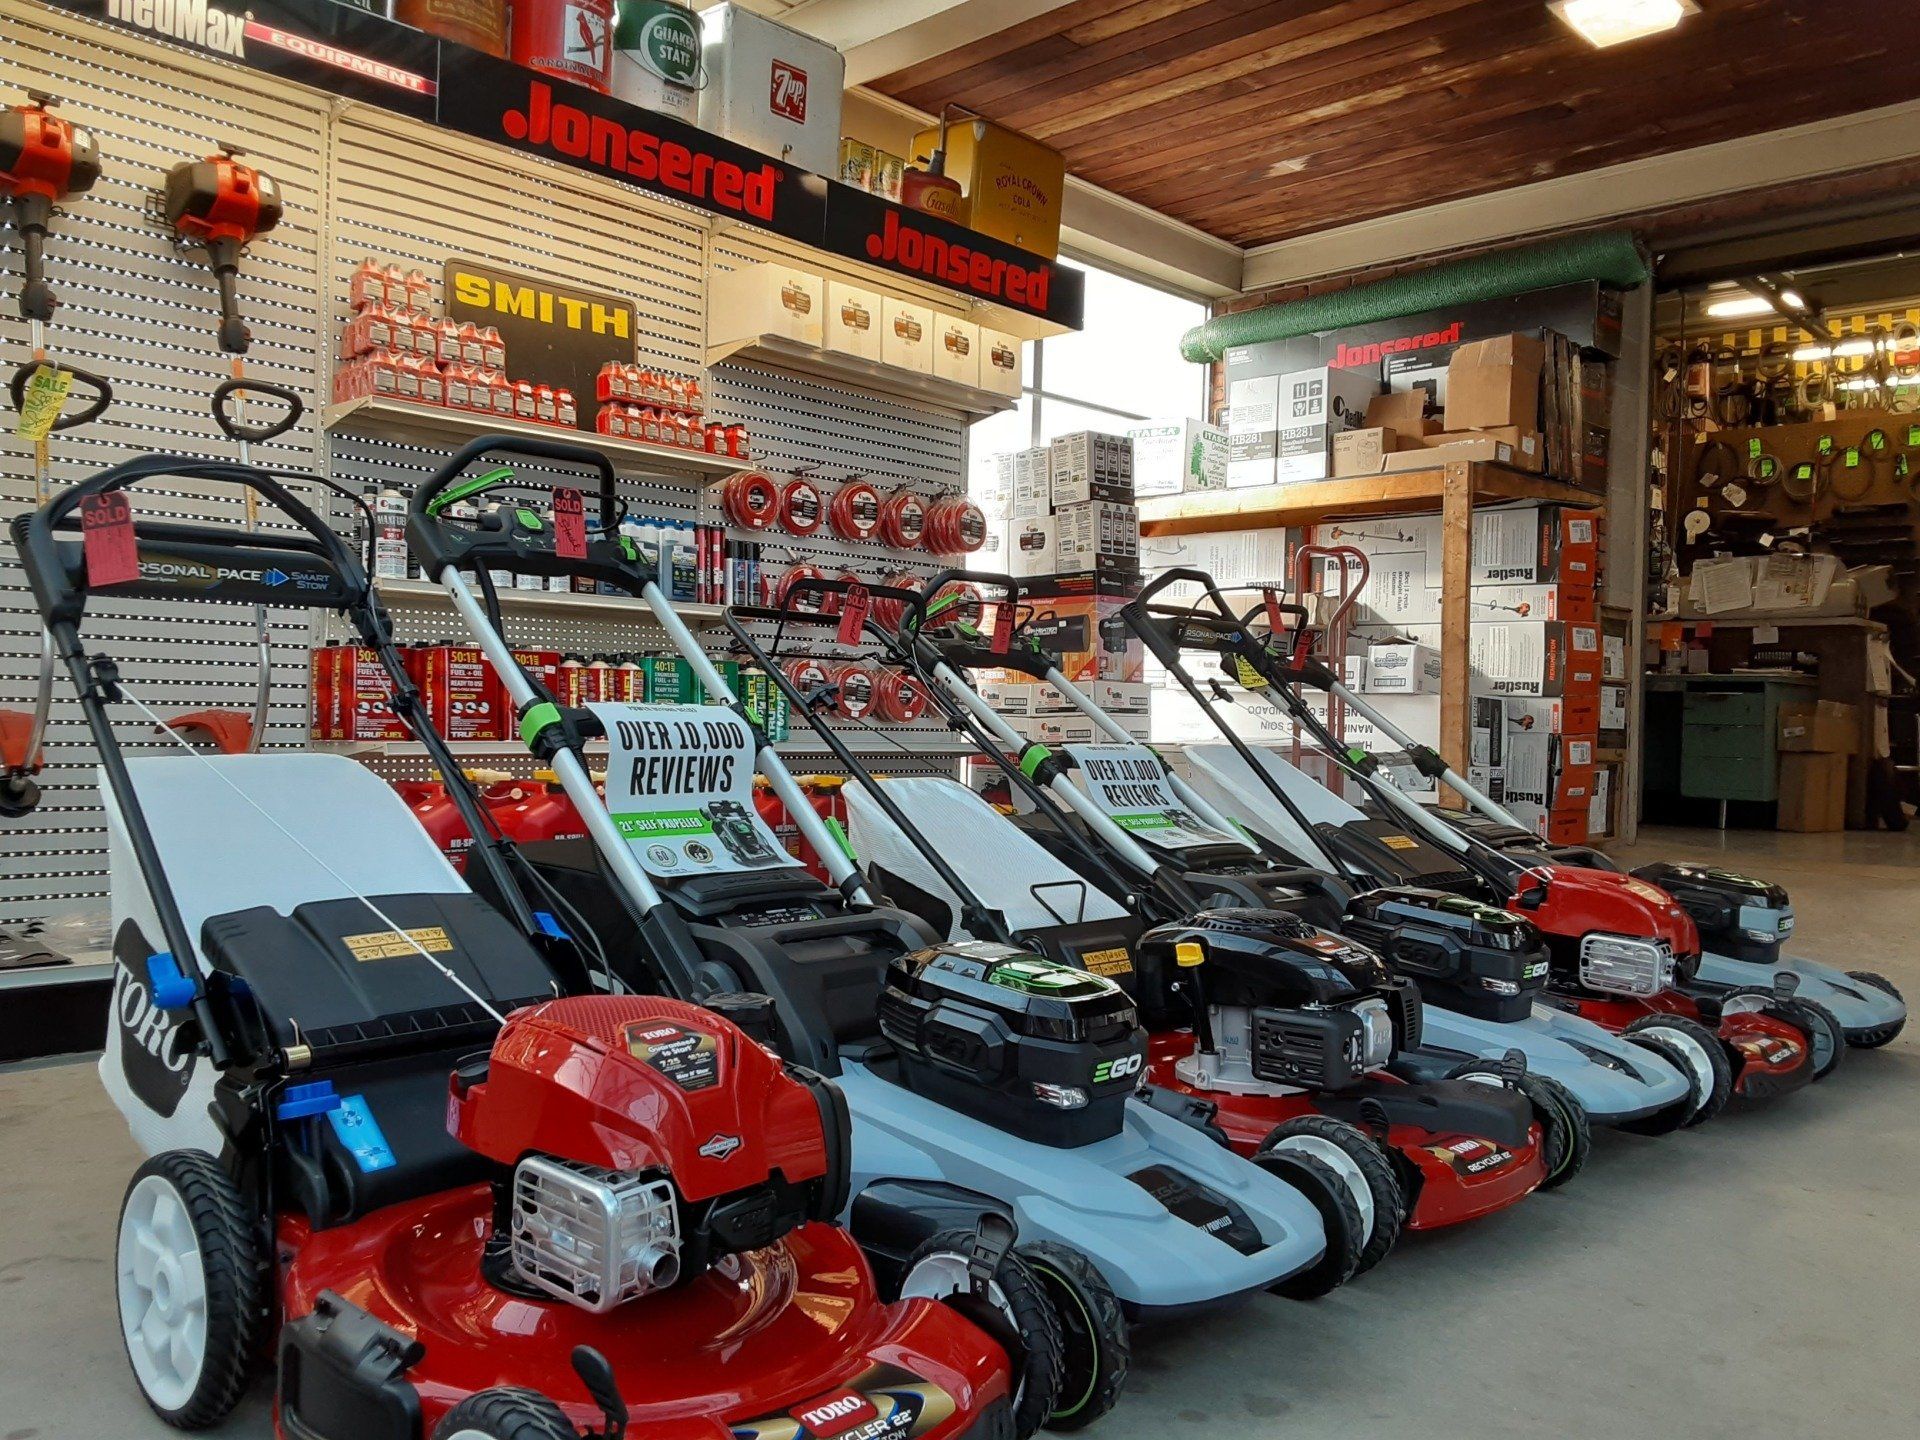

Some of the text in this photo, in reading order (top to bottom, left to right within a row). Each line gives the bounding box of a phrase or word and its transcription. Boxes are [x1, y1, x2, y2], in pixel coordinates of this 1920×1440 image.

[108, 0, 246, 58] edMax
[653, 25, 697, 50] QUAKER
[269, 31, 424, 89] EQUIPMENT
[659, 44, 691, 67] STATE
[503, 80, 775, 221] Jonsered
[995, 174, 1049, 207] ROYAL CROWN
[1013, 195, 1031, 209] COLA
[866, 208, 1051, 311] Jonsered
[455, 272, 629, 339] SMITH
[1327, 321, 1460, 369] Jonsered
[35, 374, 67, 393] SALE
[1203, 430, 1229, 446] ITASC
[1231, 432, 1263, 445] HB281
[1281, 426, 1314, 440] HB281
[555, 498, 581, 511] SOLD
[85, 506, 128, 524] SOLD
[137, 561, 262, 581] RSONAL PACE
[1326, 559, 1362, 571] Rutle
[1486, 567, 1534, 581] Rustler
[291, 571, 330, 582] SMART
[296, 580, 328, 590] STOW
[451, 651, 471, 663] 50:1
[654, 661, 671, 672] 40:1
[1549, 638, 1557, 681] REMINGTON
[473, 669, 483, 677] OIL
[1492, 681, 1540, 694] Rustler
[357, 731, 405, 739] TRUFUEL
[615, 720, 745, 754] OVER 10,000
[629, 754, 735, 796] REVIEWS
[1085, 759, 1161, 783] OVER 10,000
[1102, 783, 1171, 807] REVIEWS
[1505, 791, 1544, 805] Rustle
[1522, 961, 1549, 980] EGO
[113, 955, 189, 1073] TORO
[640, 1026, 678, 1040] TORO
[648, 1036, 697, 1053] Guaranteed
[661, 1044, 692, 1057] to Start
[1092, 1053, 1143, 1083] EGO
[1467, 1153, 1503, 1173] RECYCLER
[801, 1395, 863, 1428] TORO
